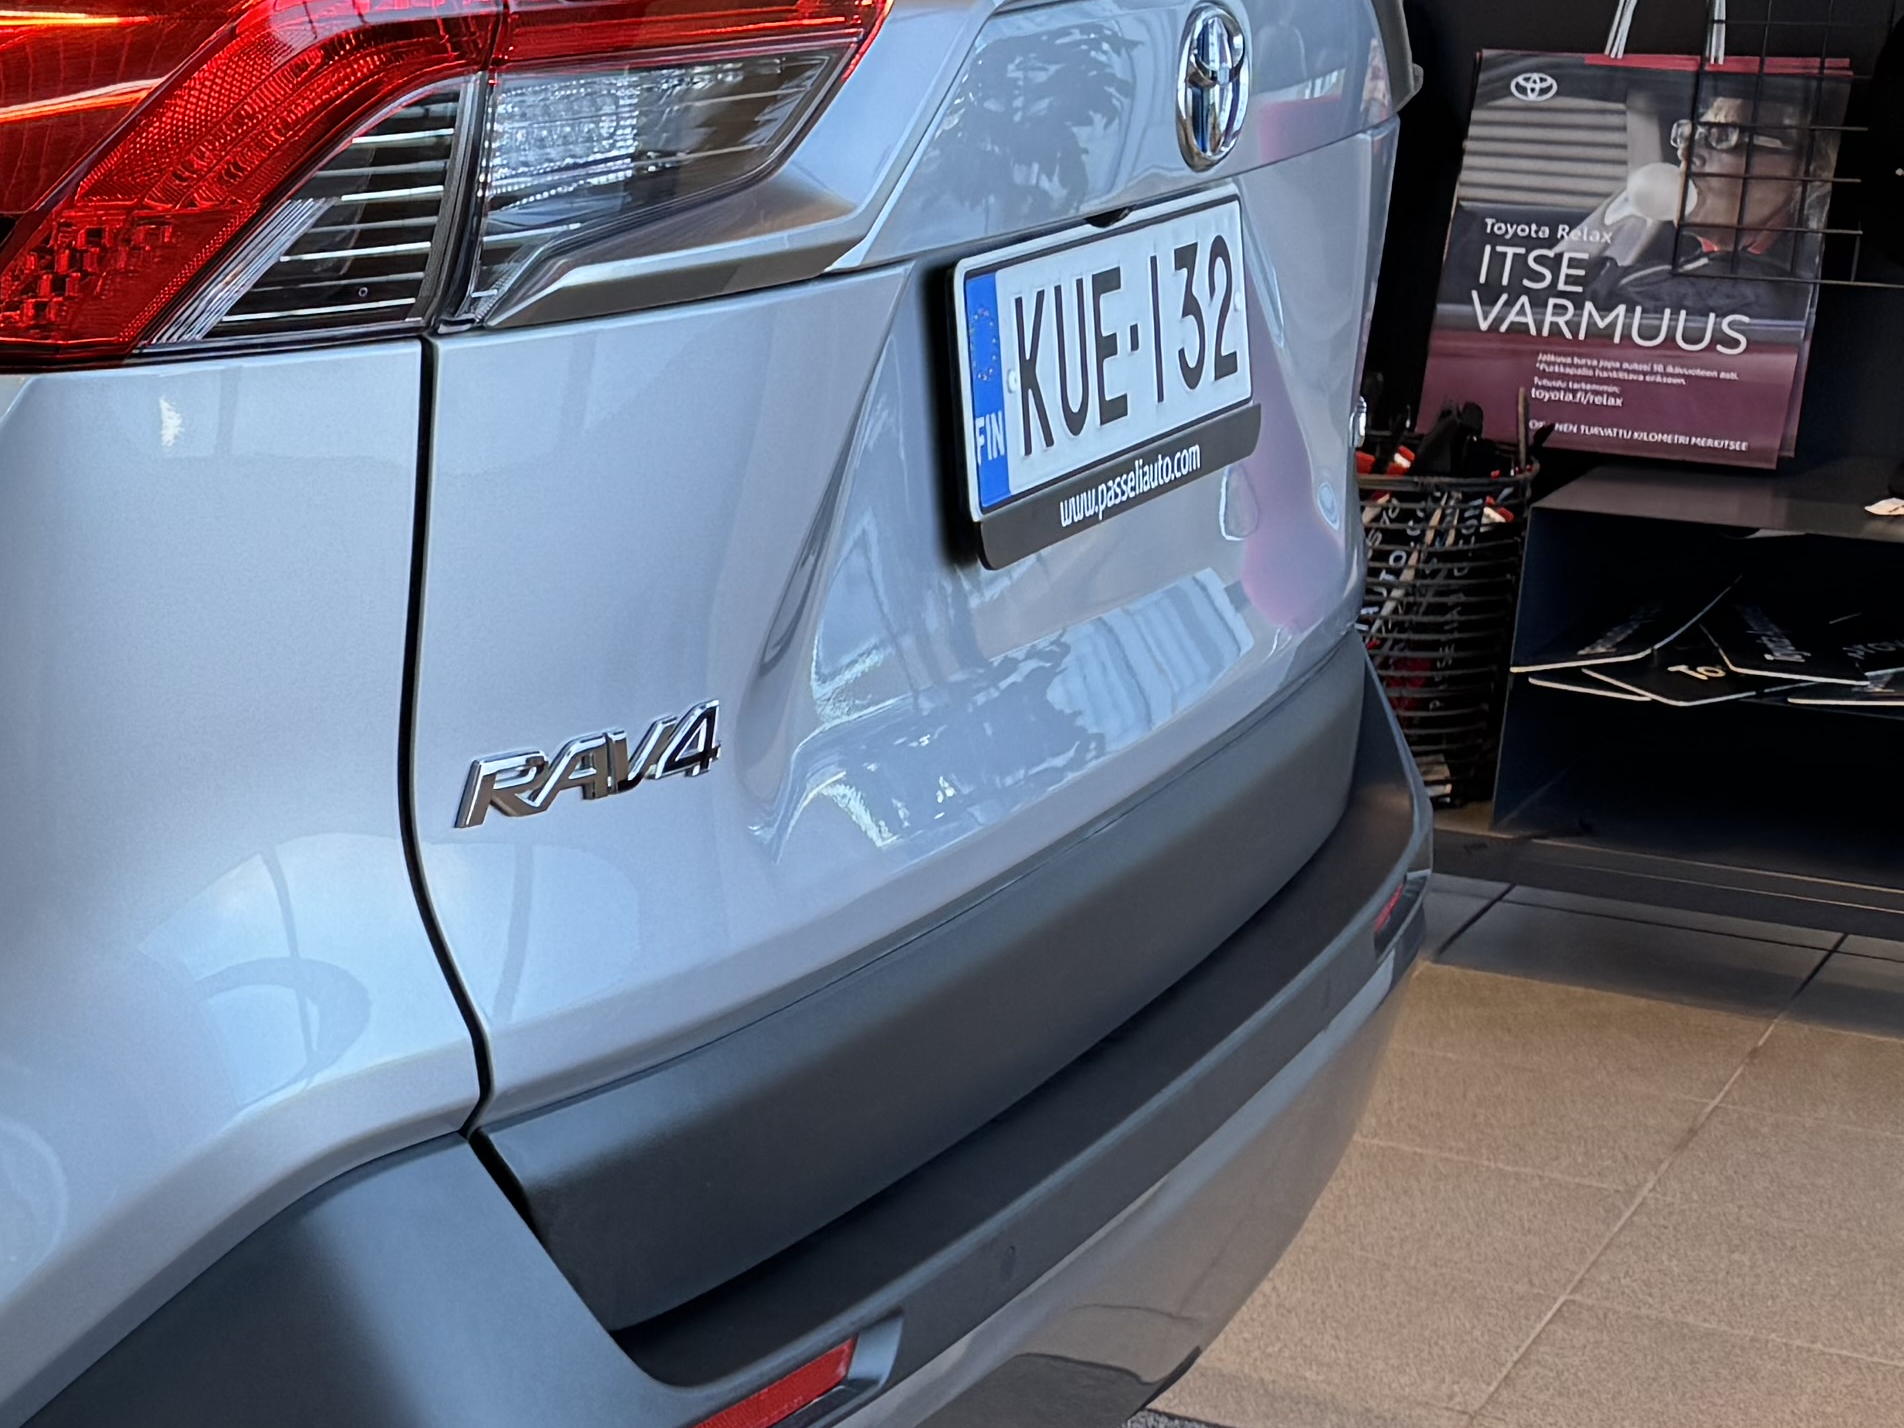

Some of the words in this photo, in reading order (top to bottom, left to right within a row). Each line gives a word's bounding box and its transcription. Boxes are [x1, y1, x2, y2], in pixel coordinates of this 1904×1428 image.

[1484, 217, 1550, 240] Toyota
[1557, 223, 1613, 245] Relax
[1478, 243, 1591, 294] ITSE
[1470, 289, 1751, 356] VARMUUS
[1530, 387, 1624, 407] toyota.fi/relax
[975, 410, 1006, 465] FIN
[1059, 443, 1201, 527] www.passeliauto.com
[452, 698, 722, 829] RAV4
